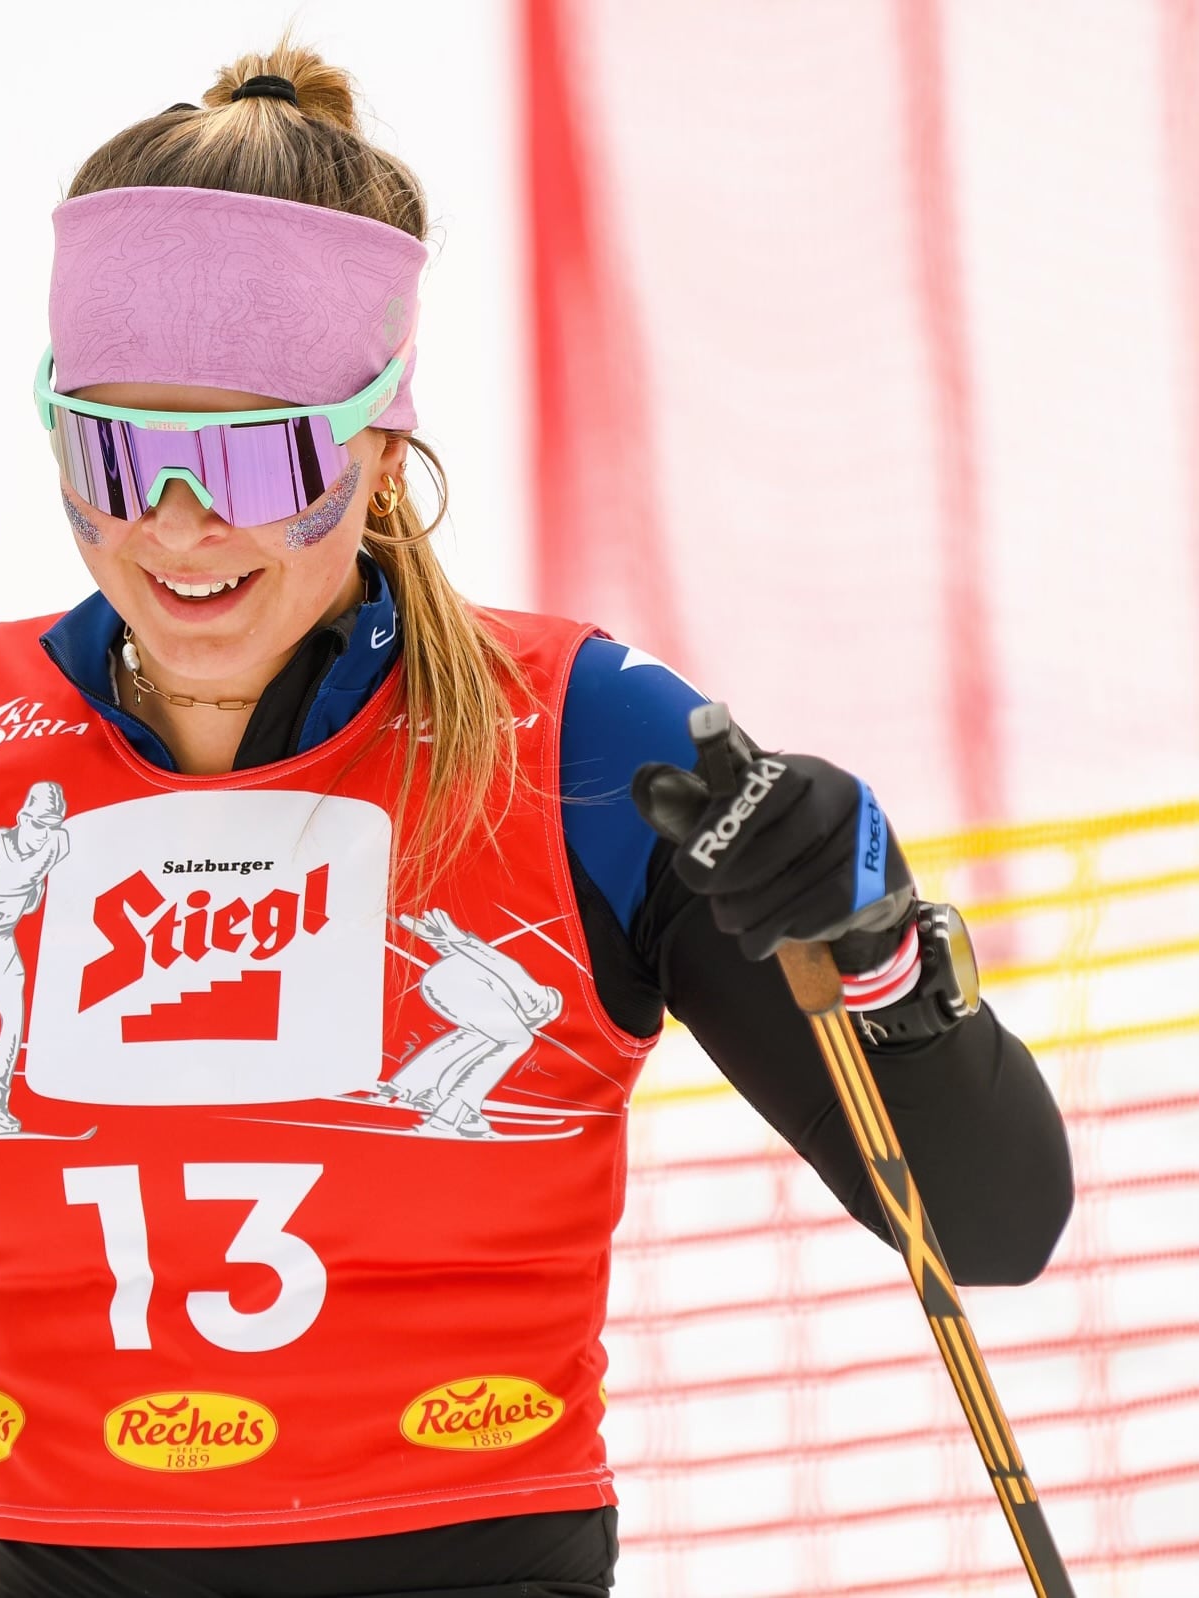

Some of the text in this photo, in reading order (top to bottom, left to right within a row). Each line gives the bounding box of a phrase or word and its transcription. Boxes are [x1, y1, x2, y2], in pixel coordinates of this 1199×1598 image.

[162, 859, 274, 875] Salzburger
[78, 863, 330, 1014] Stiegl
[62, 1162, 327, 1353] 13
[117, 1407, 264, 1447] Recheis
[417, 1393, 554, 1435] Recheis
[472, 1430, 513, 1447] 1889
[166, 1454, 210, 1468] 1889
